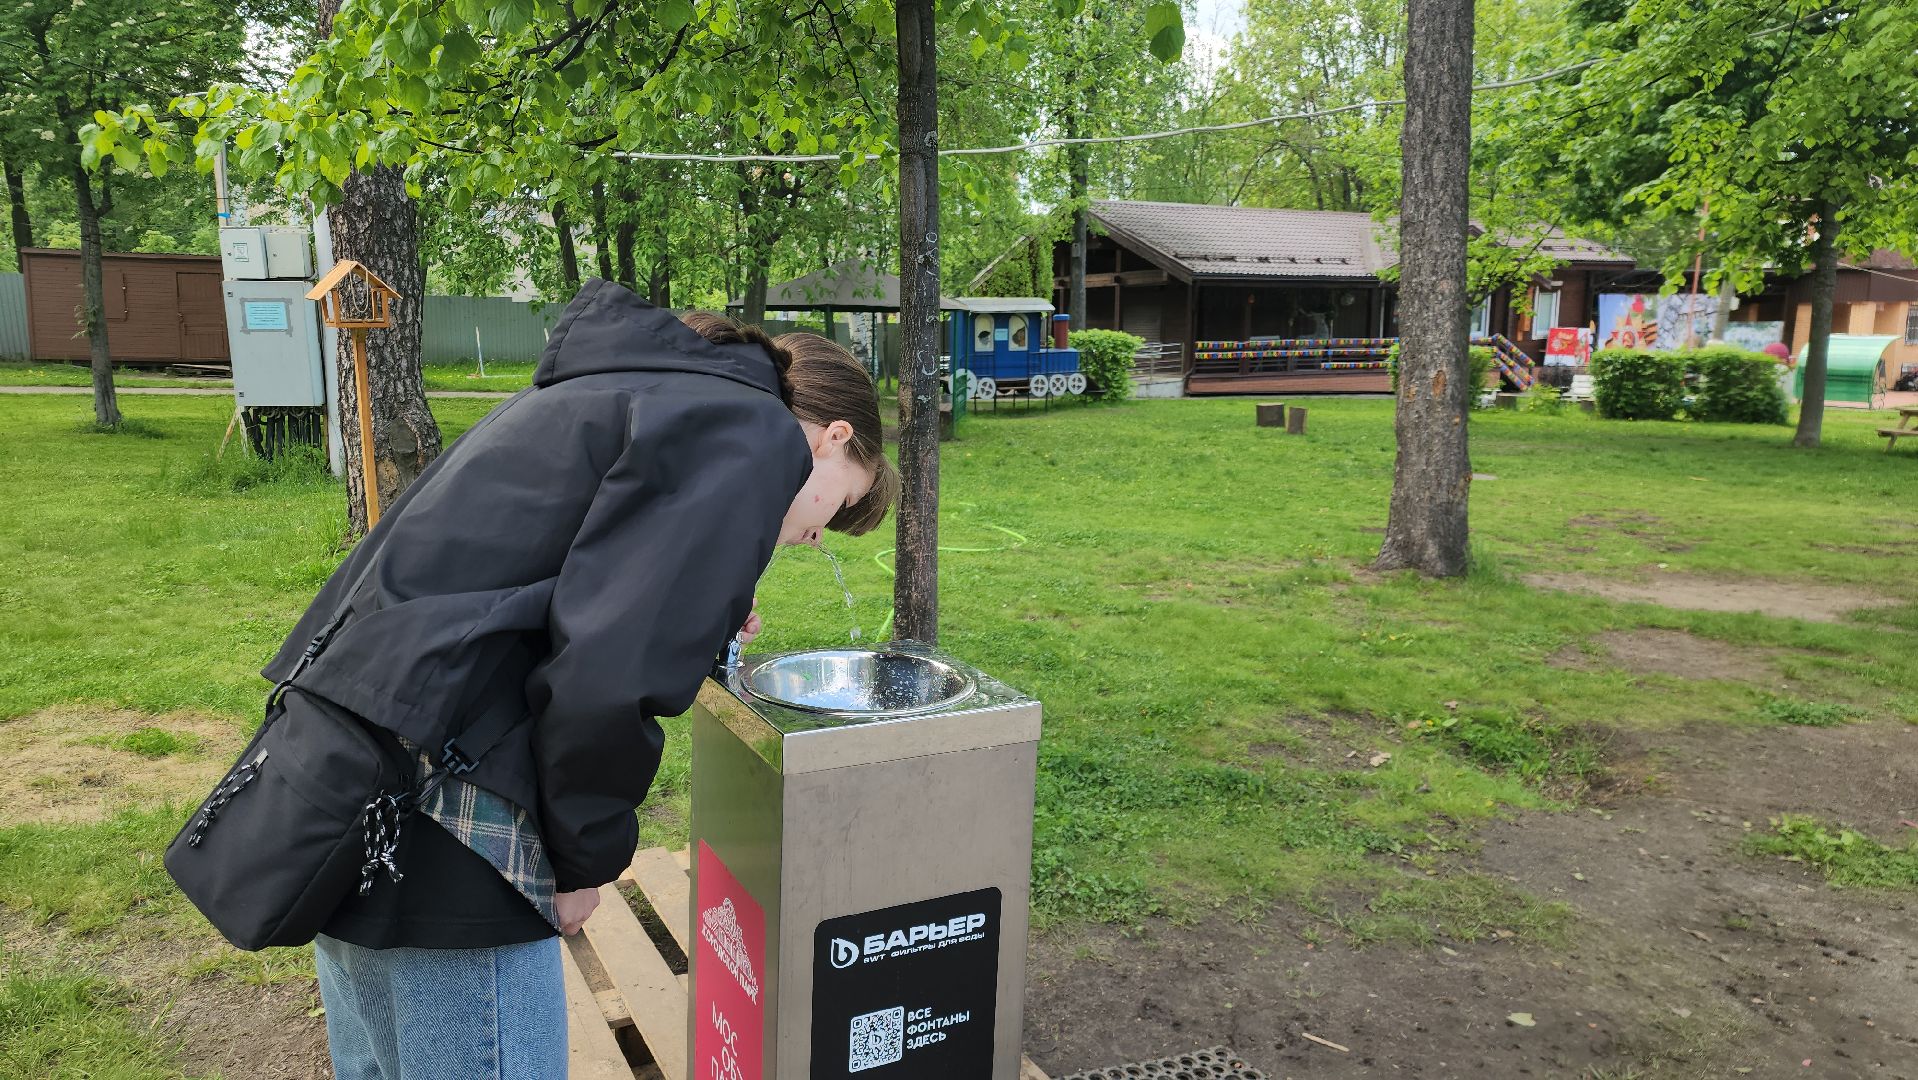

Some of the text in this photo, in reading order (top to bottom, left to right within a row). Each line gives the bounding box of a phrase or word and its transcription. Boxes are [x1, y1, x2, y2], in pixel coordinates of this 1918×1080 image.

[864, 913, 986, 955] БАРЬЕР
[906, 1010, 970, 1035] ФОНТАНЫ
[907, 1007, 932, 1022] ВСЕ
[712, 1000, 738, 1058] МОС
[906, 1031, 947, 1050] ЗДЕСЬ
